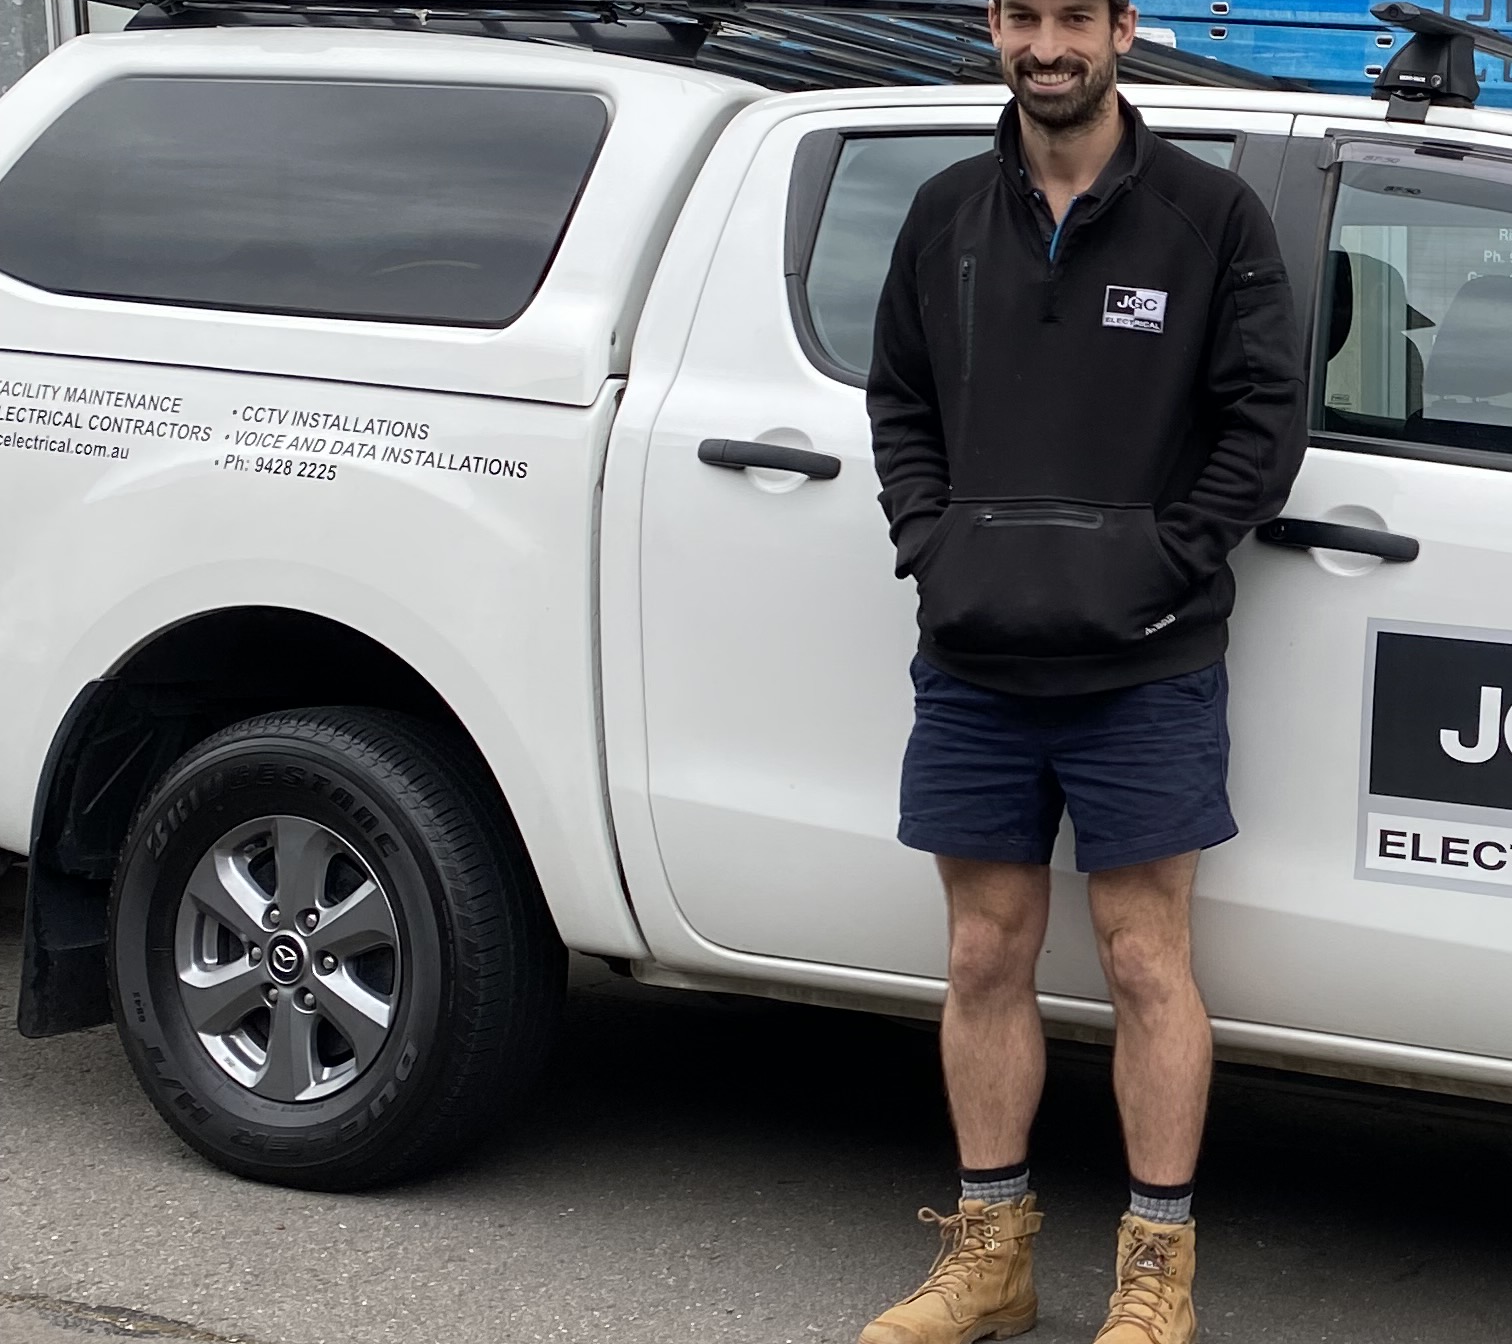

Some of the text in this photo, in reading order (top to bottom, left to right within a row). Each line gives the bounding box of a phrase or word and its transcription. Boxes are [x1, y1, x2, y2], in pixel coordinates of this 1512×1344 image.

[1116, 294, 1158, 311] JGC
[1105, 316, 1160, 330] ELECTRICAL
[0, 380, 183, 414] ACILITY MAINTENANCE
[88, 414, 212, 442] CONTRACTORS
[241, 405, 430, 440] CCTV INSTALLATIONS
[223, 454, 337, 481] Ph: 9428 2225
[234, 430, 528, 479] VOICE AND DATA INSTALLATIONS
